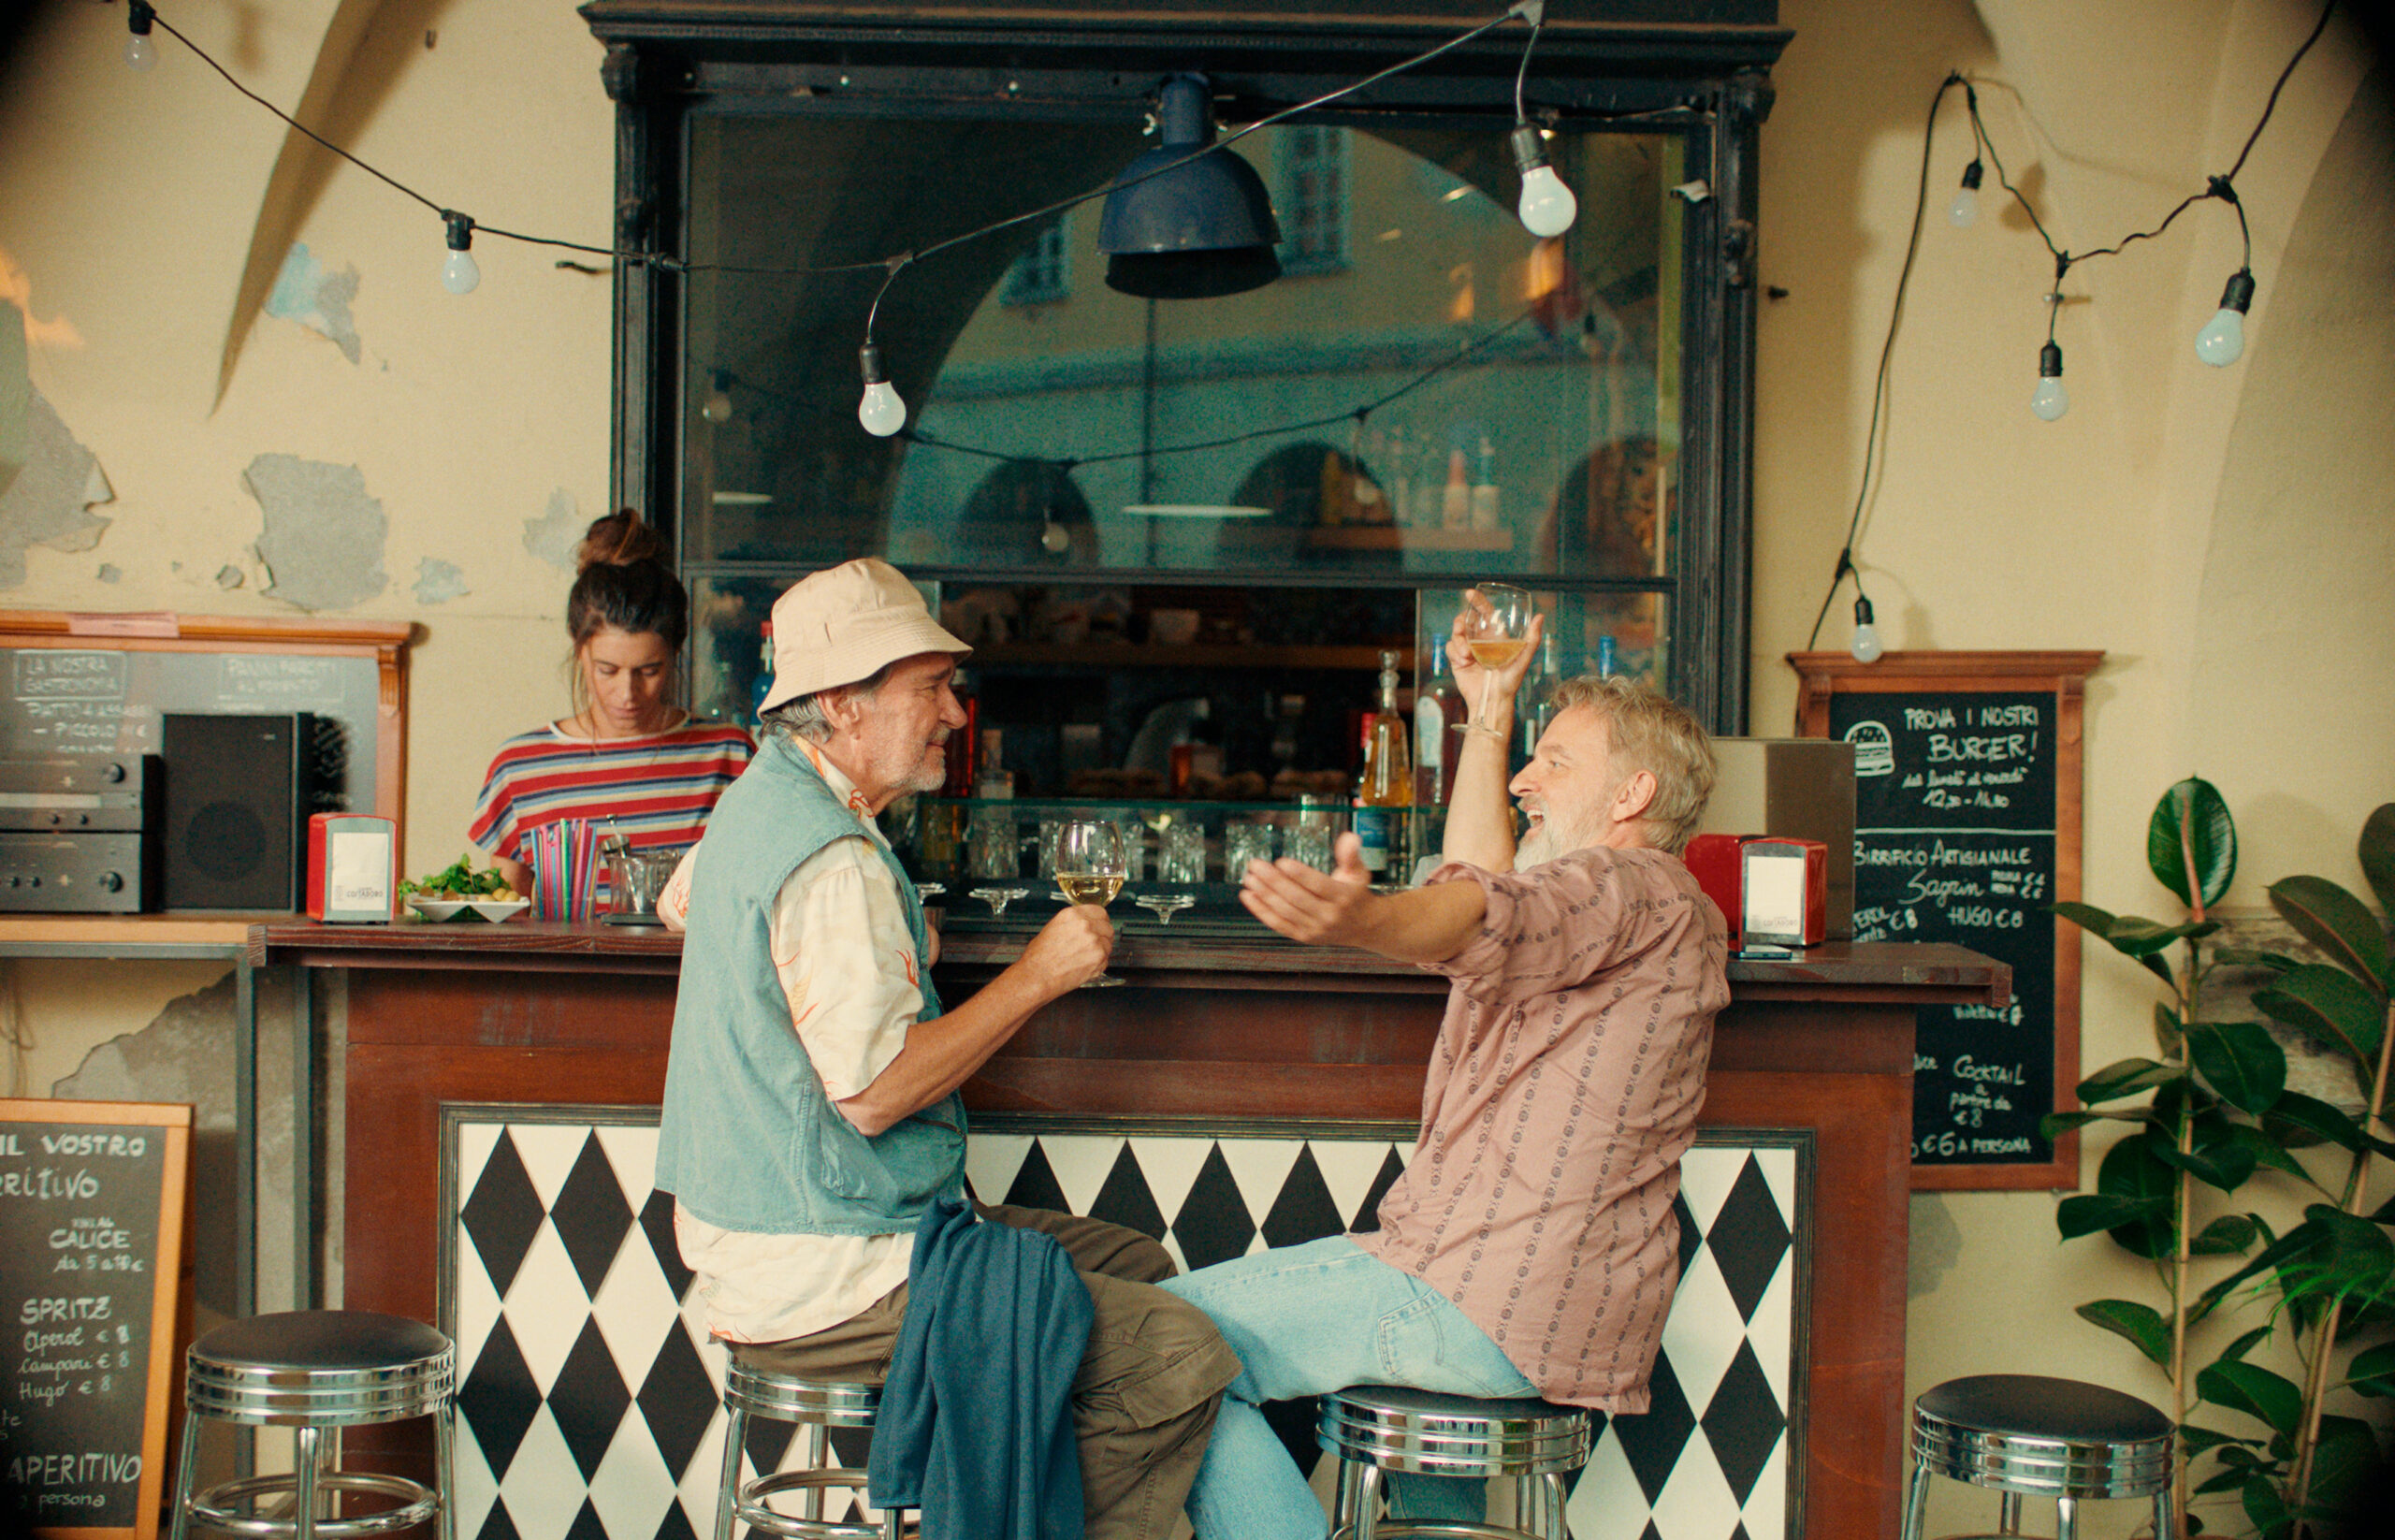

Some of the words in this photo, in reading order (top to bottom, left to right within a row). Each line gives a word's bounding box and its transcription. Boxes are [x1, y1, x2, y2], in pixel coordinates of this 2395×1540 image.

[1904, 707, 1957, 731] PROVA
[1967, 707, 1973, 726] I
[1981, 705, 2039, 727] NOSTRI
[1930, 838, 2032, 868] ARTIGIANALE
[1946, 906, 1994, 926] HUGO
[1952, 1054, 2026, 1086] COCKTAIL
[40, 1132, 147, 1157] VOSTRO
[1971, 1135, 2032, 1155] PERSONA
[49, 1228, 131, 1250] CALICE
[19, 1296, 112, 1325] SPRITZ
[22, 1325, 85, 1357] Aperol
[17, 1354, 94, 1381] Campari
[19, 1380, 70, 1407] Hugo
[7, 1452, 142, 1486] APERITIVO
[38, 1492, 106, 1514] persona
